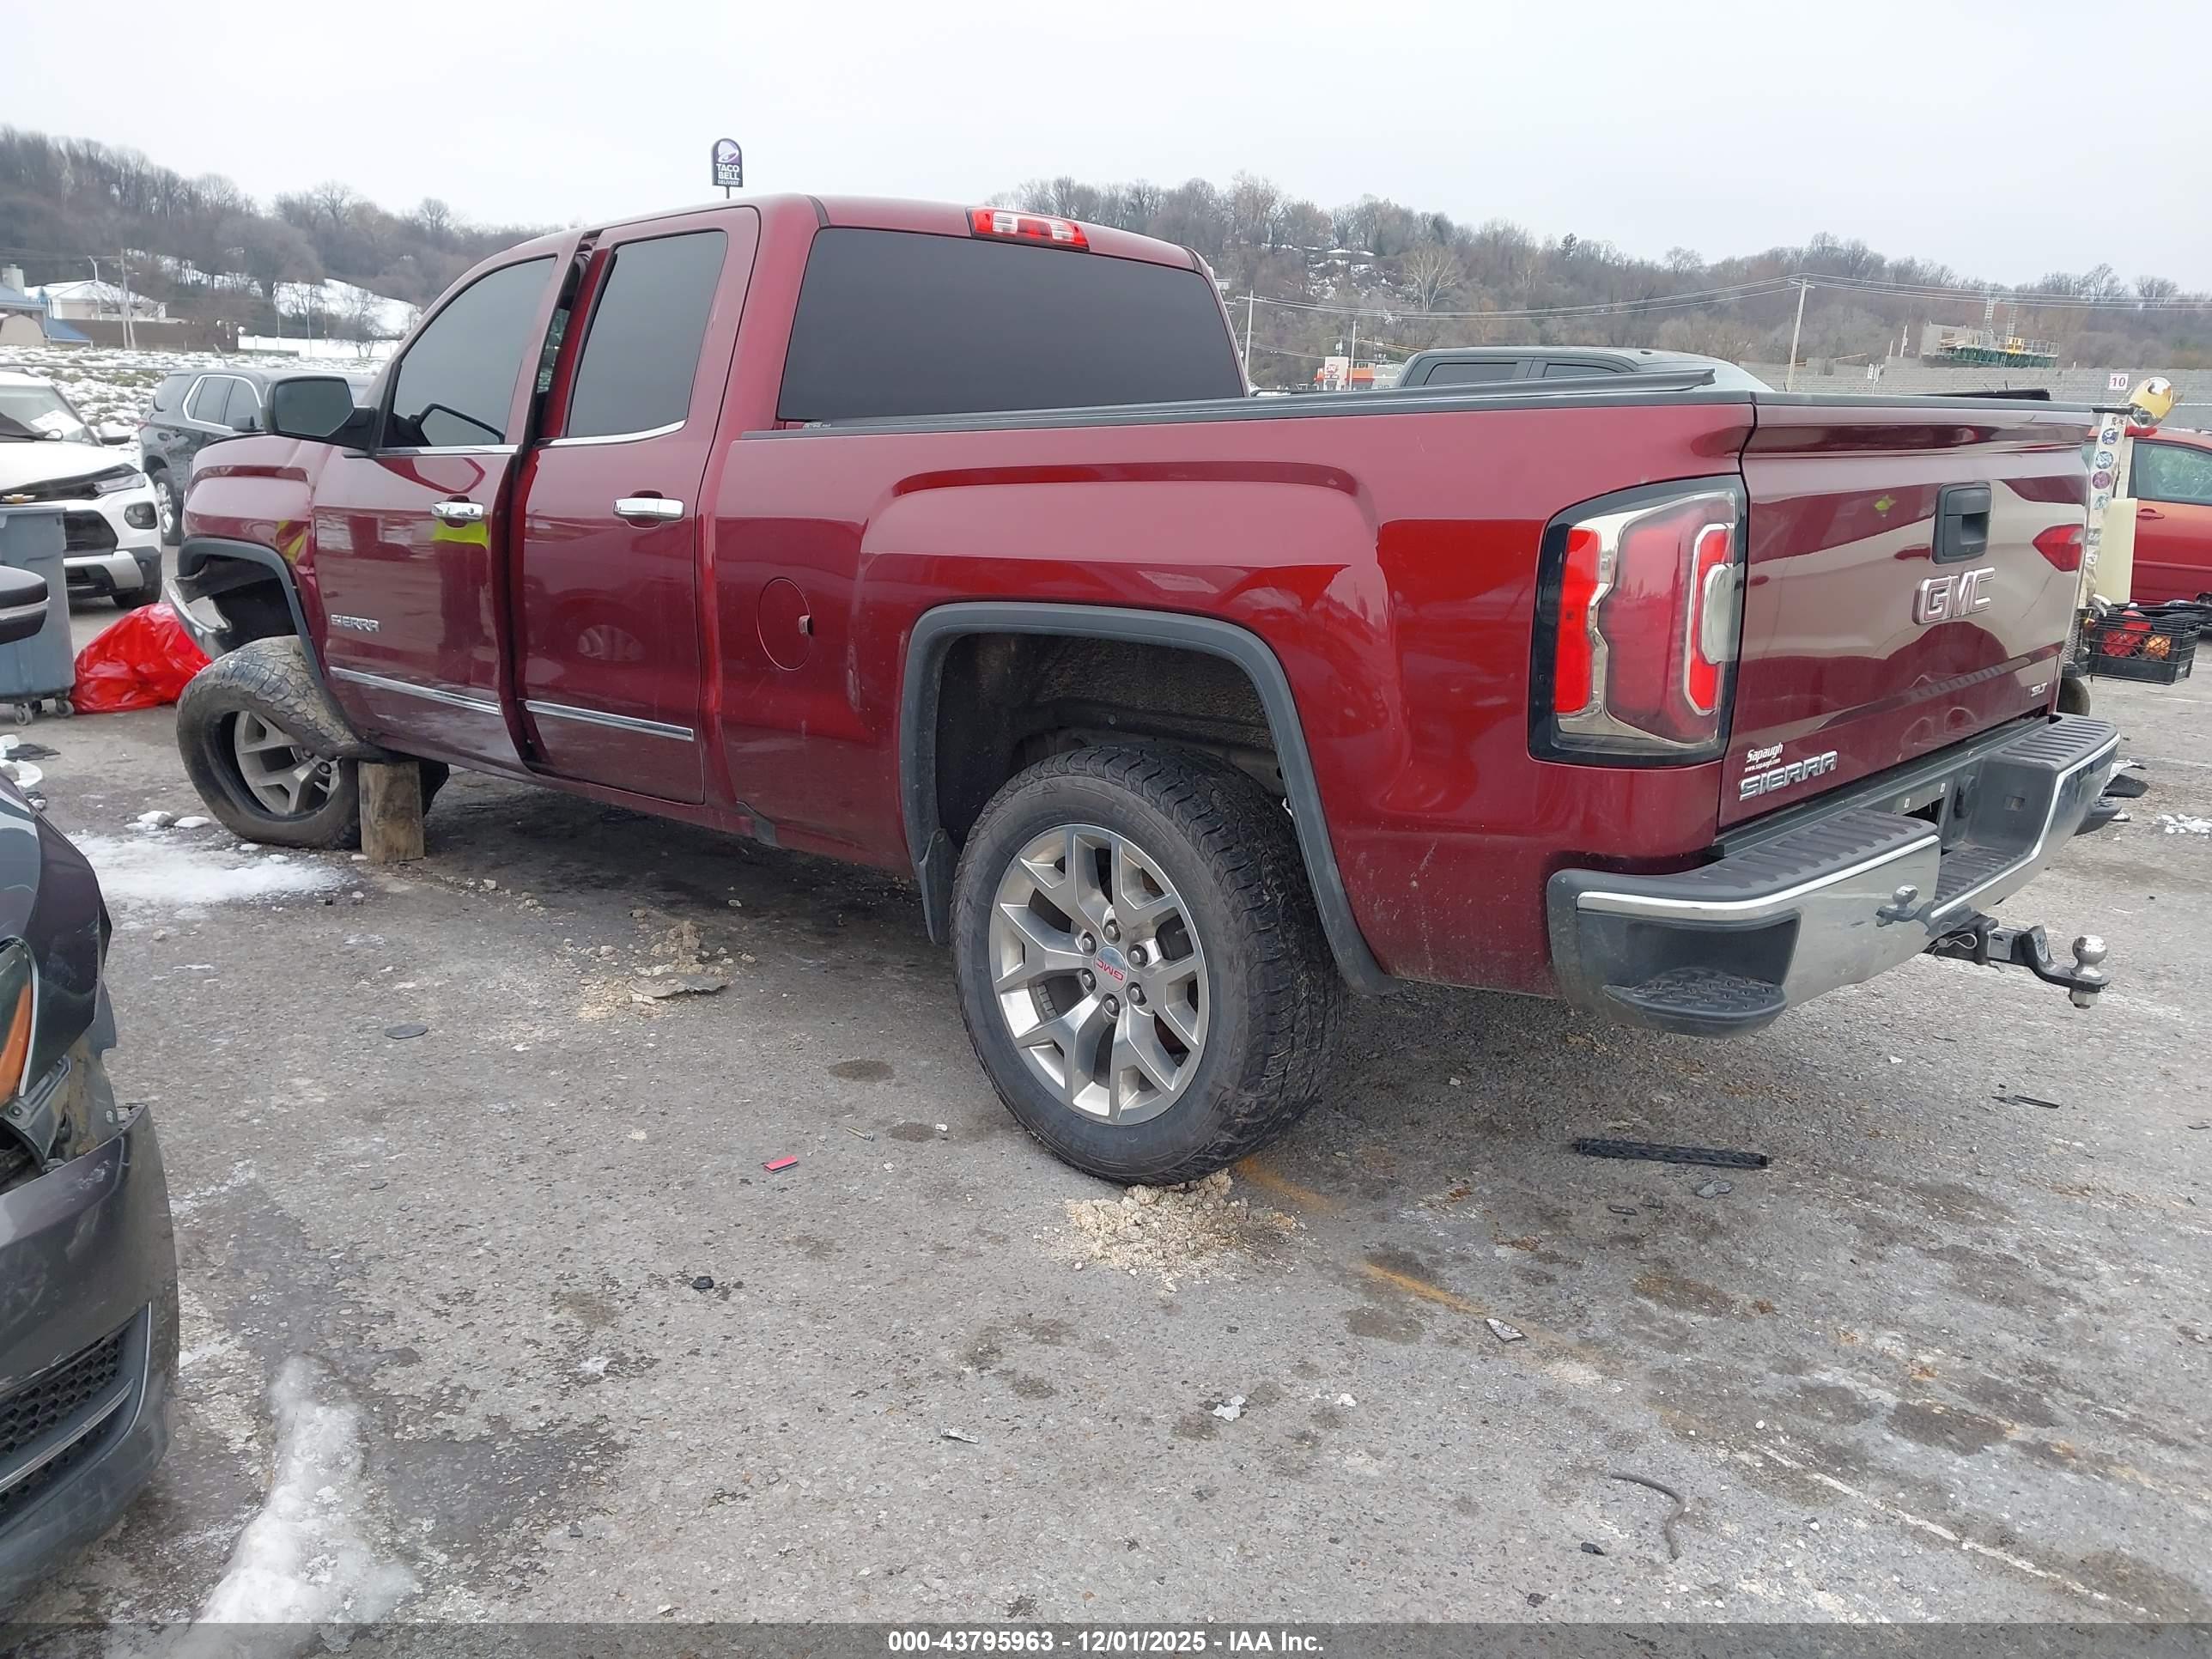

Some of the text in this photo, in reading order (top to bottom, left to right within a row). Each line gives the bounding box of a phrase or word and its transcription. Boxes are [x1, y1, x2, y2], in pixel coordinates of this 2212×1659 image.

[716, 163, 739, 172] TACO
[718, 172, 739, 180] BELL
[2112, 377, 2126, 387] 10
[1913, 567, 1996, 624] GMC
[330, 614, 380, 632] SIERRA
[2030, 682, 2048, 697] SLT
[1746, 742, 1784, 764] Sapaugh
[1738, 750, 1838, 801] SIERRA
[1096, 958, 1125, 981] GMC
